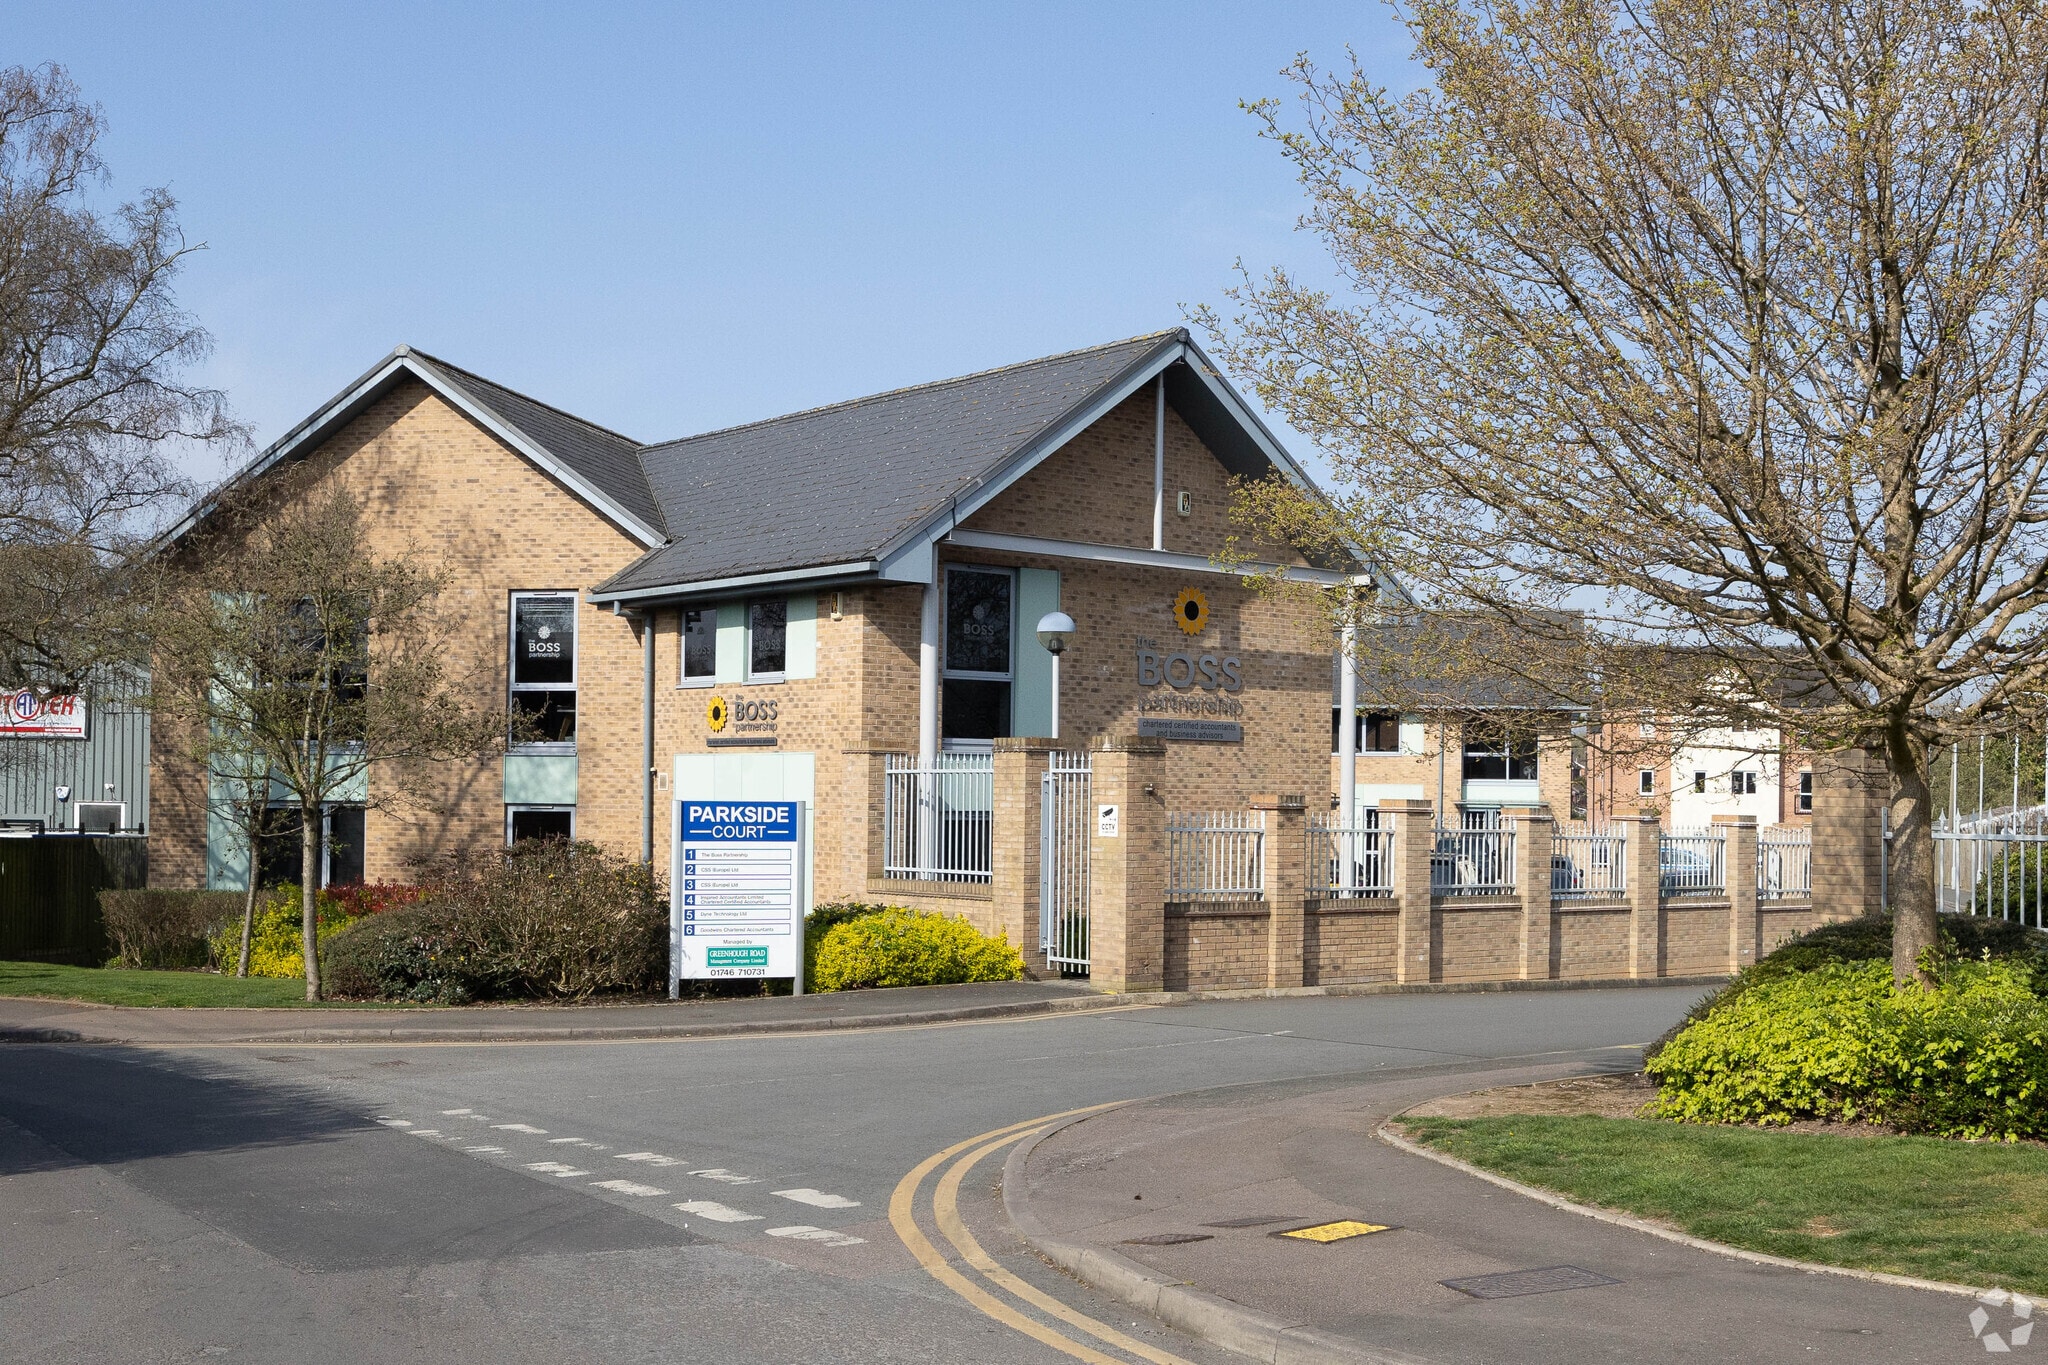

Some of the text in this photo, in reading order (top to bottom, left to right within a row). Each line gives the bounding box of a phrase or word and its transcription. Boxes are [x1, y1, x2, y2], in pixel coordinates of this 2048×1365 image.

[963, 623, 995, 635] BOSS
[528, 642, 560, 652] BOSS
[1136, 637, 1157, 648] the
[1136, 651, 1242, 691] BOSS
[734, 700, 778, 721] BOSS
[1138, 693, 1243, 718] partnership
[735, 721, 778, 734] partnership
[1142, 720, 1237, 731] chartered certified accountants
[1169, 730, 1197, 738] business
[1198, 731, 1224, 739] advisors
[690, 806, 789, 823] PARKSIDE
[712, 825, 766, 838] COURT
[688, 850, 693, 859] 1
[687, 865, 694, 874] 2
[687, 880, 693, 890] 3
[686, 895, 694, 904] 4
[686, 910, 693, 920] 5
[686, 925, 693, 935] 6
